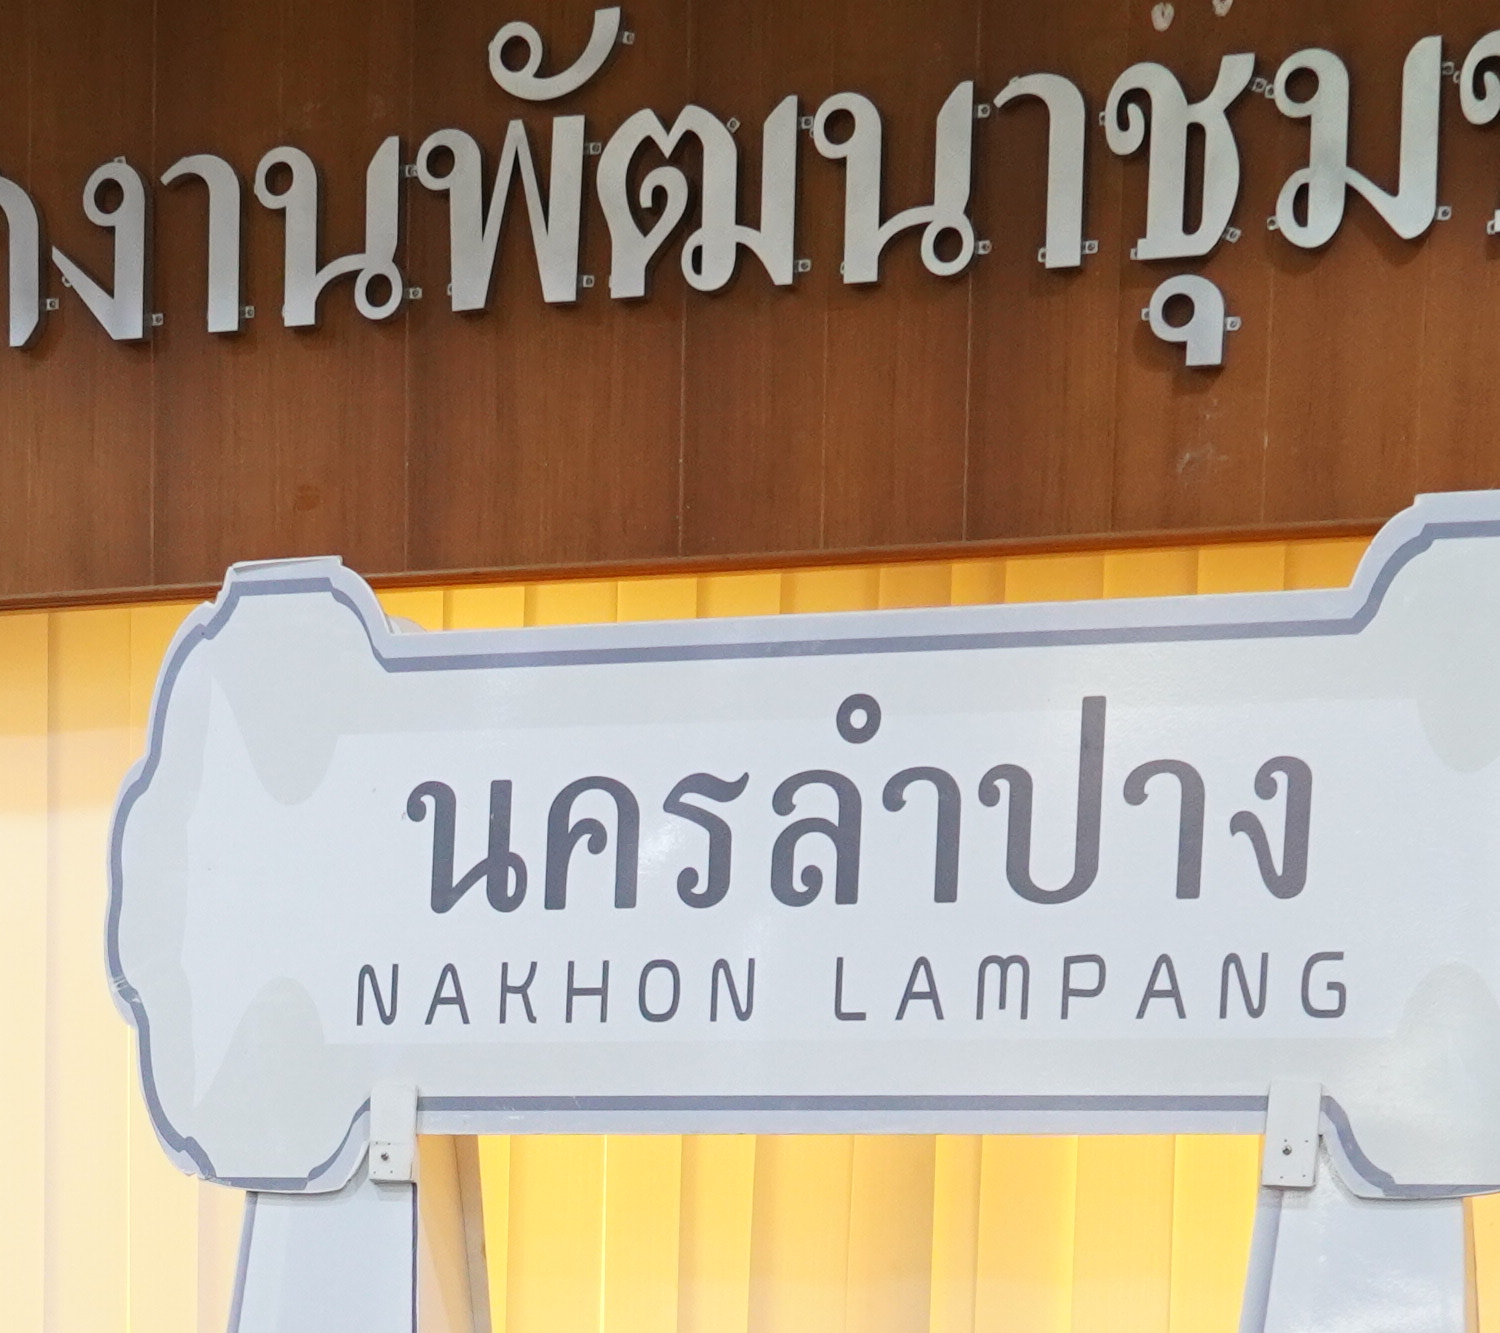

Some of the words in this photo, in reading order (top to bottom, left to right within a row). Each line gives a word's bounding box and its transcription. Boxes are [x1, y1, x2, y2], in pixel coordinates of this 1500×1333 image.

[406, 692, 1315, 915] นครลำปาง
[355, 953, 760, 1027] NAKHON
[833, 949, 1350, 1023] LAMPANG
